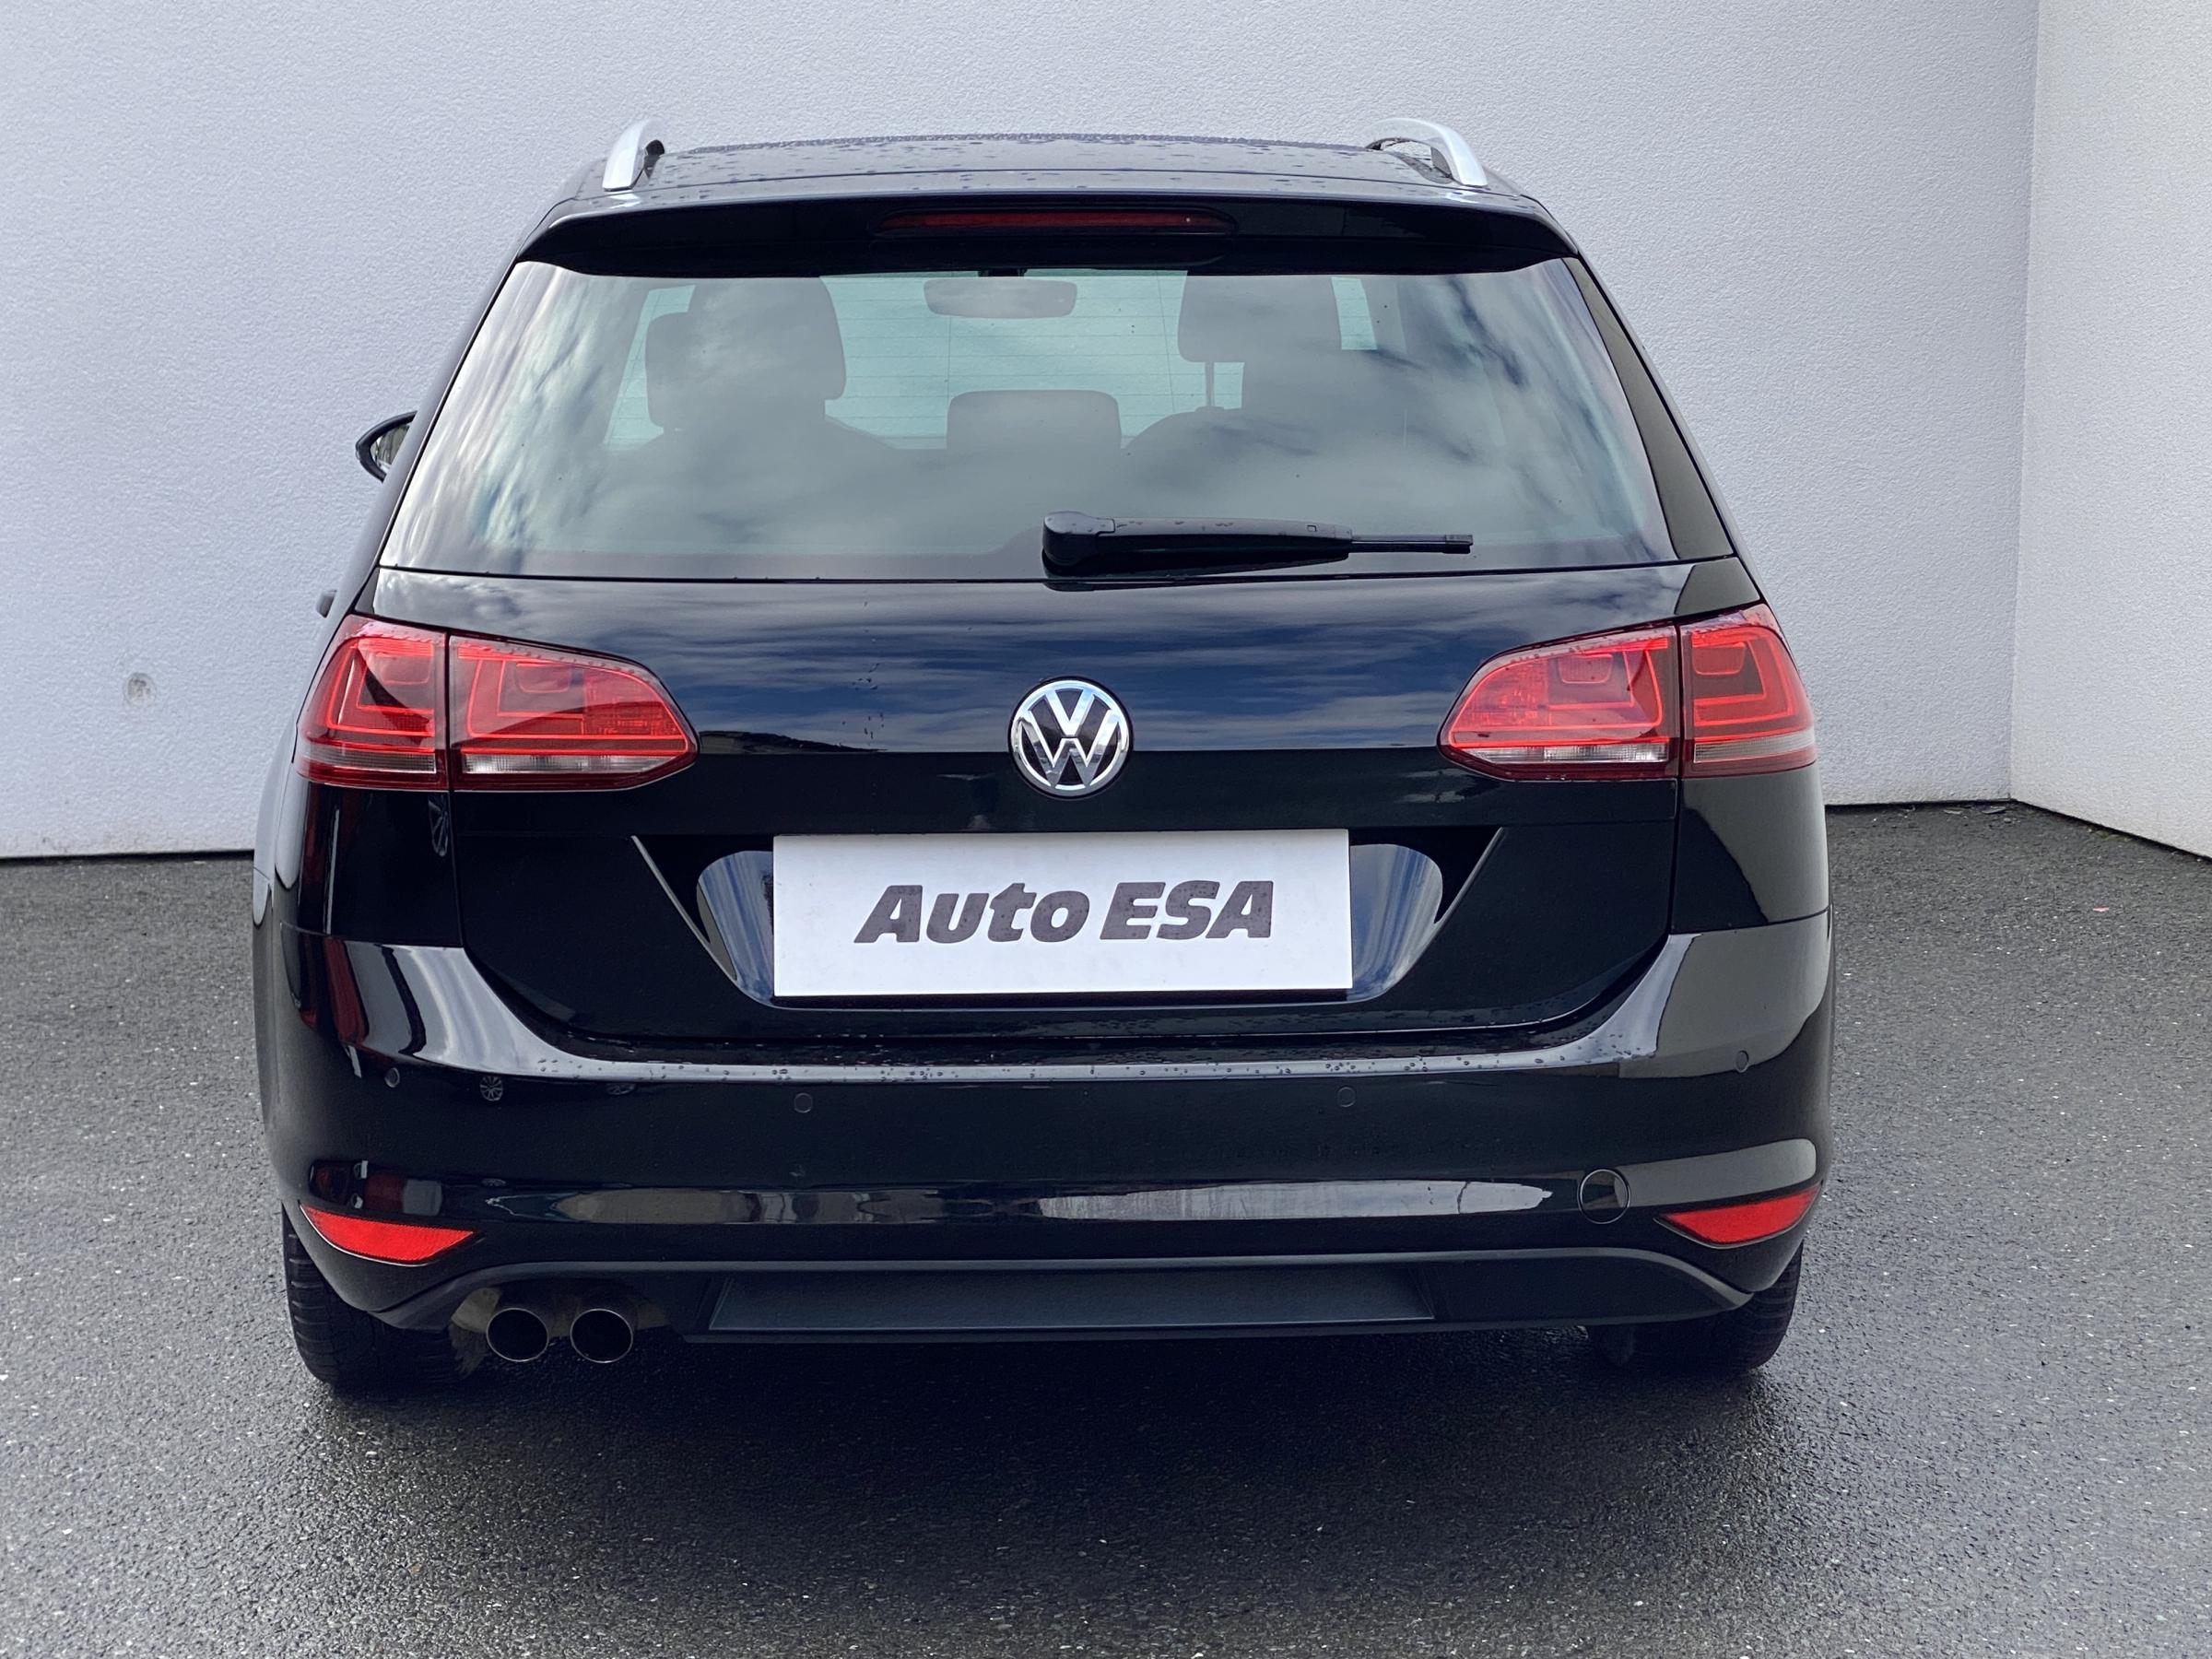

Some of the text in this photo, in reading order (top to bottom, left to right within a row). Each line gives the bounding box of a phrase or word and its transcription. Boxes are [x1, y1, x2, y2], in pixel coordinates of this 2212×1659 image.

[1015, 684, 1126, 791] VW
[853, 879, 1274, 944] Auto ESA
